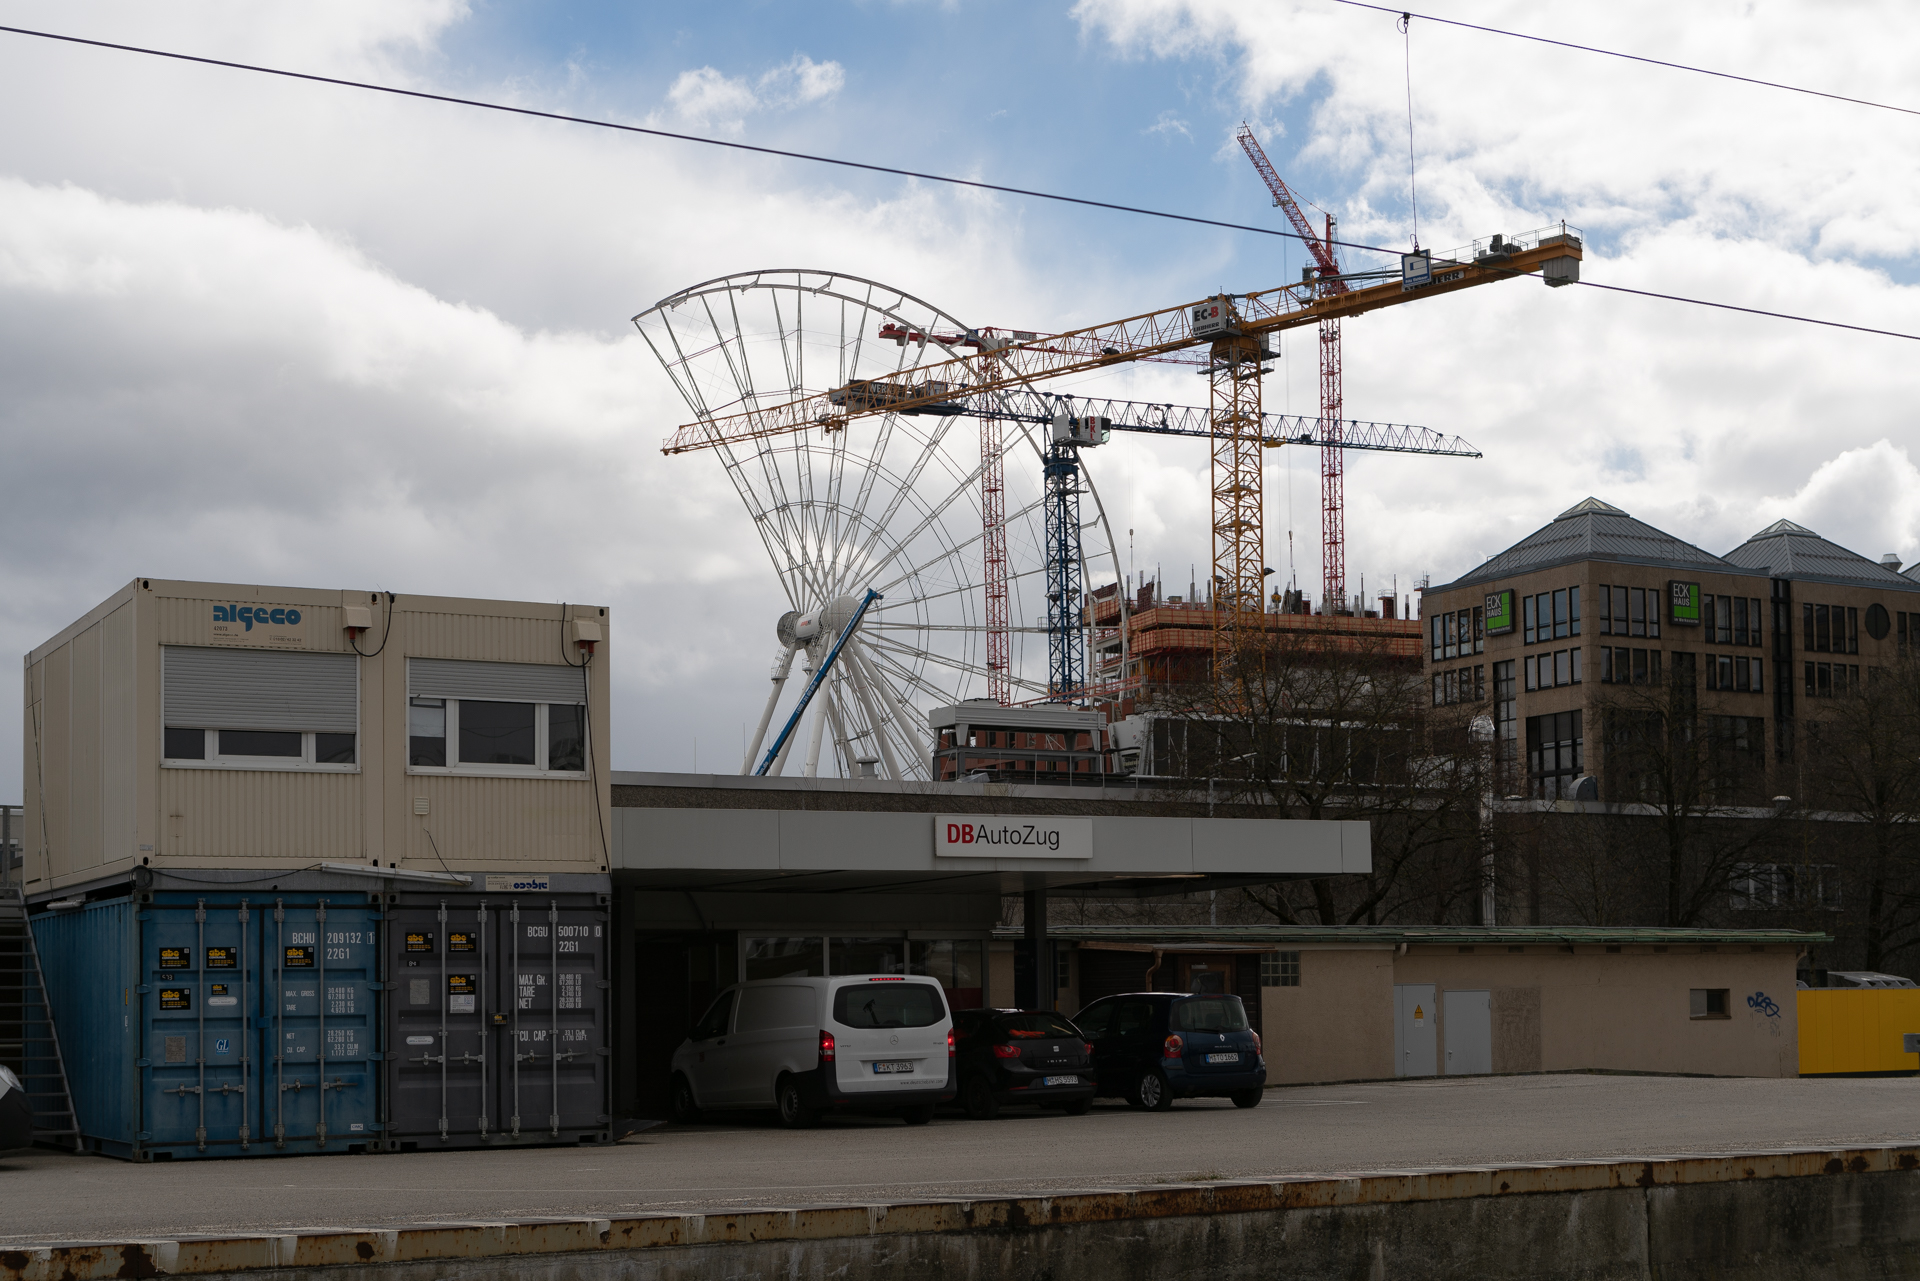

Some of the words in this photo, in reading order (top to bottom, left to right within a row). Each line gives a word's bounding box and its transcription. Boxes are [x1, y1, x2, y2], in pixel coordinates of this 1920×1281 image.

[1194, 306, 1219, 322] EC-B
[1673, 583, 1689, 597] ECK
[1487, 594, 1501, 609] ECK
[1674, 597, 1690, 606] HAUS
[213, 604, 301, 632] algeco
[1487, 608, 1502, 617] HAUS
[527, 926, 548, 937] BCGU
[558, 926, 588, 937] 500710
[292, 932, 315, 944] BCHU
[327, 932, 361, 944] 209132
[559, 941, 579, 952] 22G1
[327, 948, 350, 960] 22G1
[520, 986, 535, 997] TARE
[519, 998, 532, 1009] NET
[519, 1030, 530, 1041] CU.
[533, 1030, 548, 1041] CAP.
[216, 1039, 228, 1050] GL
[896, 1062, 913, 1071] 3963
